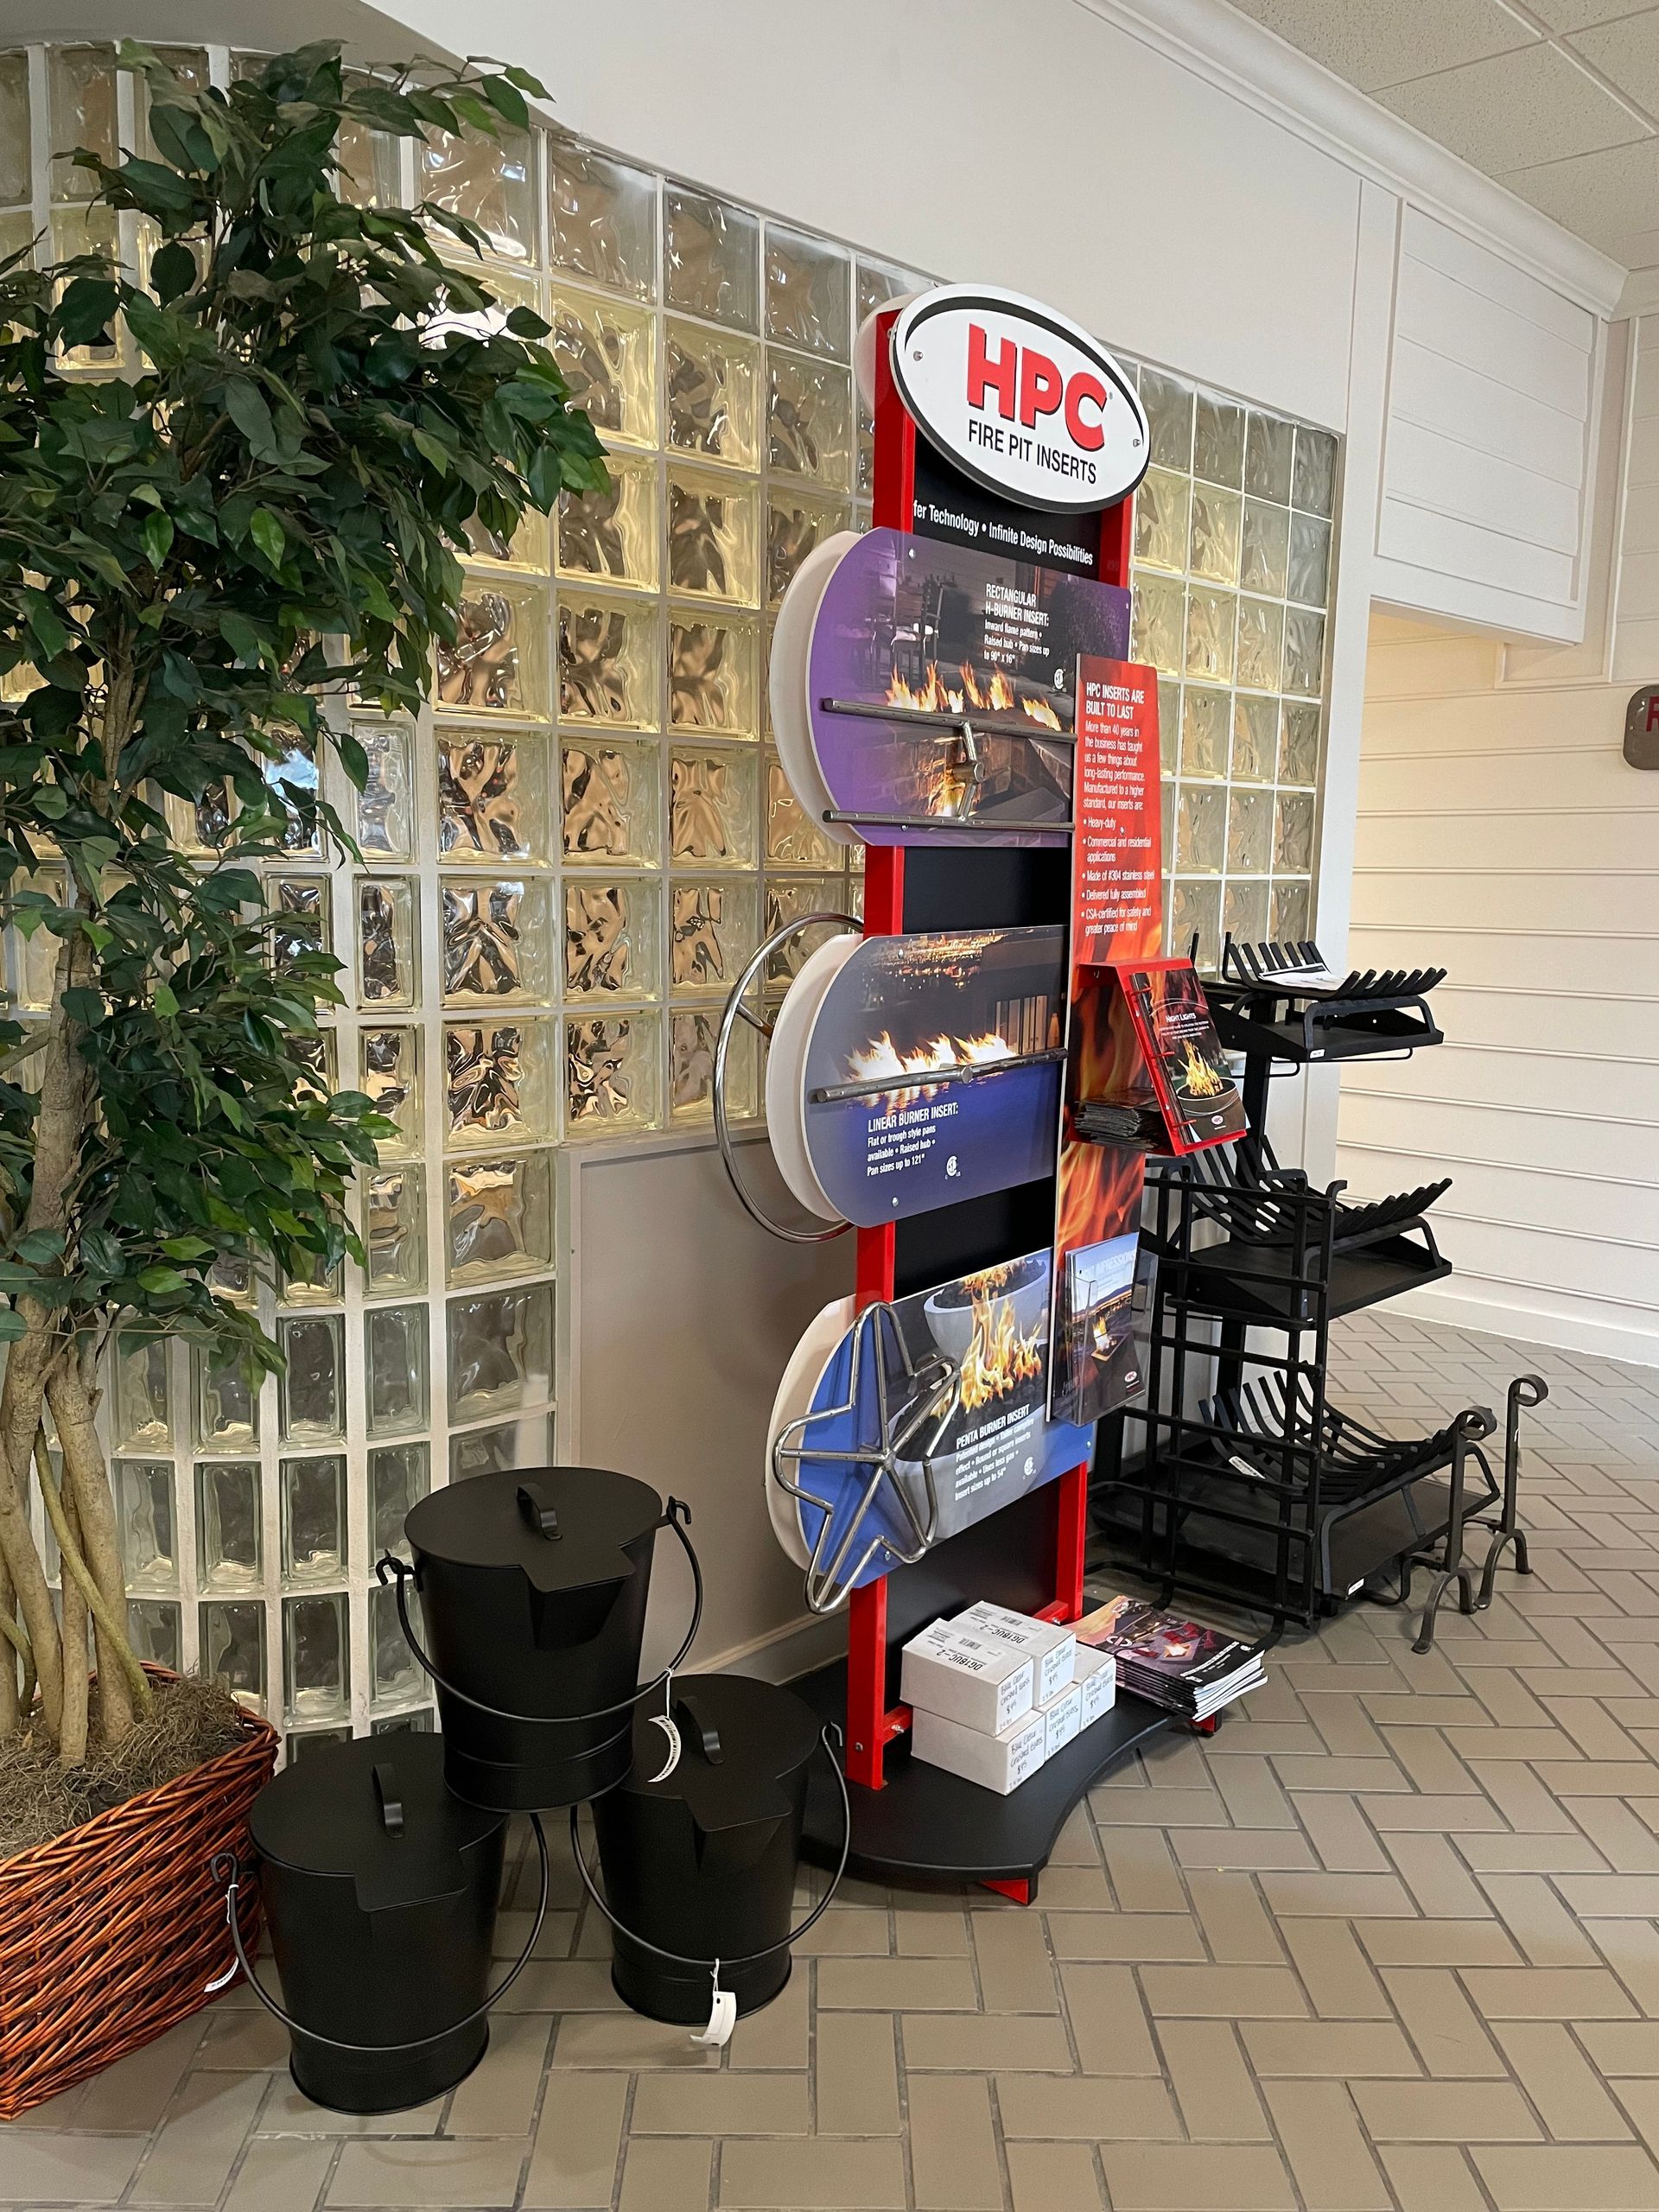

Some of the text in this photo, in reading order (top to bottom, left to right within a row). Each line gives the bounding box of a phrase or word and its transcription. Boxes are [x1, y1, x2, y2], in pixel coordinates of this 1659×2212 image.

[967, 323, 1107, 451] HPC
[969, 419, 1096, 484] FIRE PIT INSERTS
[929, 504, 979, 537] Technology
[989, 521, 1018, 545] Infinite
[1020, 531, 1046, 554] Design
[1049, 539, 1092, 565] Possibilities
[987, 583, 1036, 607] RECTANGULAR
[986, 601, 1049, 626] H-BURNER INSERT:
[984, 635, 1049, 657] Raised hub Pan sizes up
[1087, 683, 1144, 703] HPC INSERTS ARE
[1086, 701, 1134, 719] BUILT TO LAST
[1085, 721, 1139, 738] More than 40 years in
[1095, 737, 1116, 749] business
[1128, 741, 1142, 753] taught
[1089, 817, 1116, 830] Heavy-duty
[1087, 836, 1151, 847] Commercial and residential
[1087, 851, 1116, 863] applications
[868, 1103, 958, 1133] LINEAR BURNER INSERT:
[868, 1136, 879, 1147] Flat
[888, 1130, 906, 1142] trough
[908, 1127, 921, 1139] style
[923, 1126, 936, 1136] pans
[868, 1139, 931, 1161] available Raised hub
[868, 1166, 879, 1176] Pan
[880, 1163, 894, 1173] sizes
[896, 1160, 903, 1171] up
[905, 1158, 910, 1166] to
[957, 1404, 1030, 1450] PENTA BURNER INSERT
